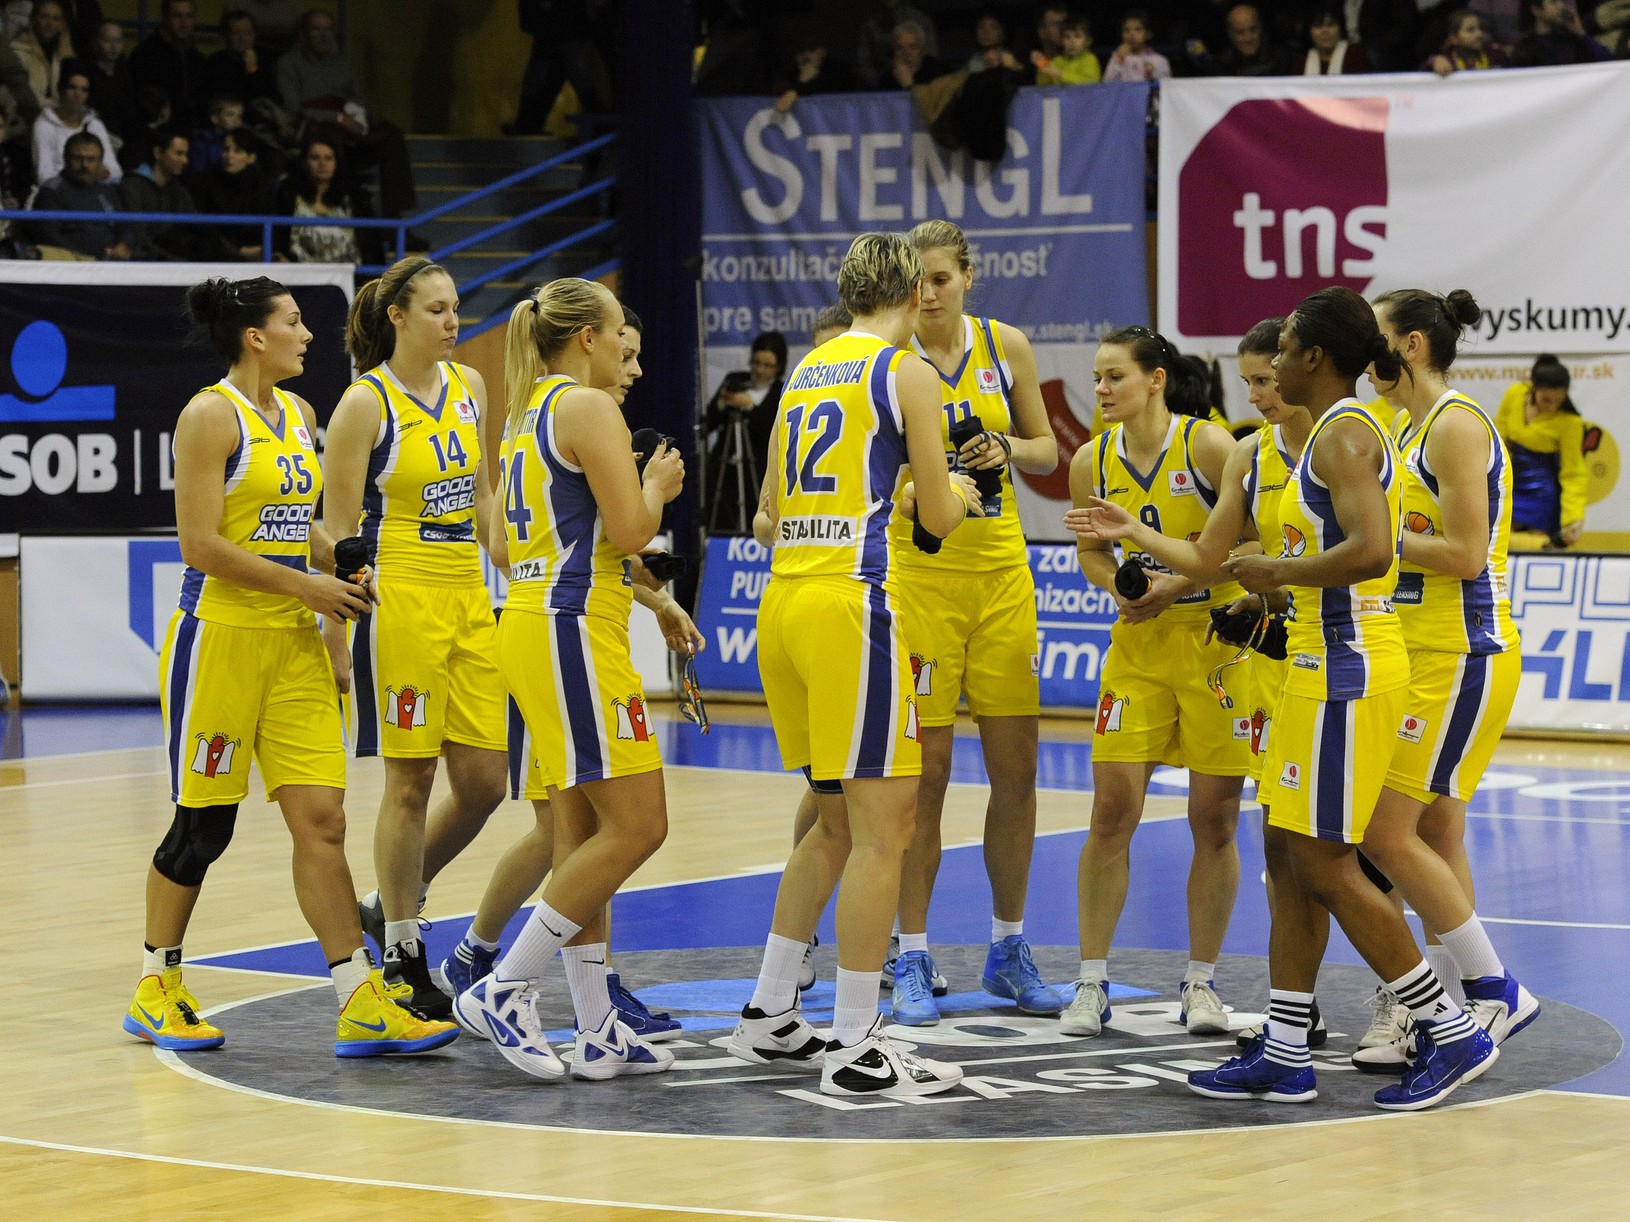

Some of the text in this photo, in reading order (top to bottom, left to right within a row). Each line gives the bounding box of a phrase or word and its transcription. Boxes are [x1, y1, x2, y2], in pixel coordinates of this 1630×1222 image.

[741, 98, 1093, 224] STENGL
[1233, 192, 1388, 280] tns
[702, 246, 846, 282] konzultač
[704, 306, 826, 340] pre sam
[428, 428, 468, 472] 14
[786, 399, 844, 498] 12
[276, 453, 313, 496] 35
[422, 474, 474, 500] GOOD
[259, 504, 312, 522] GOOD
